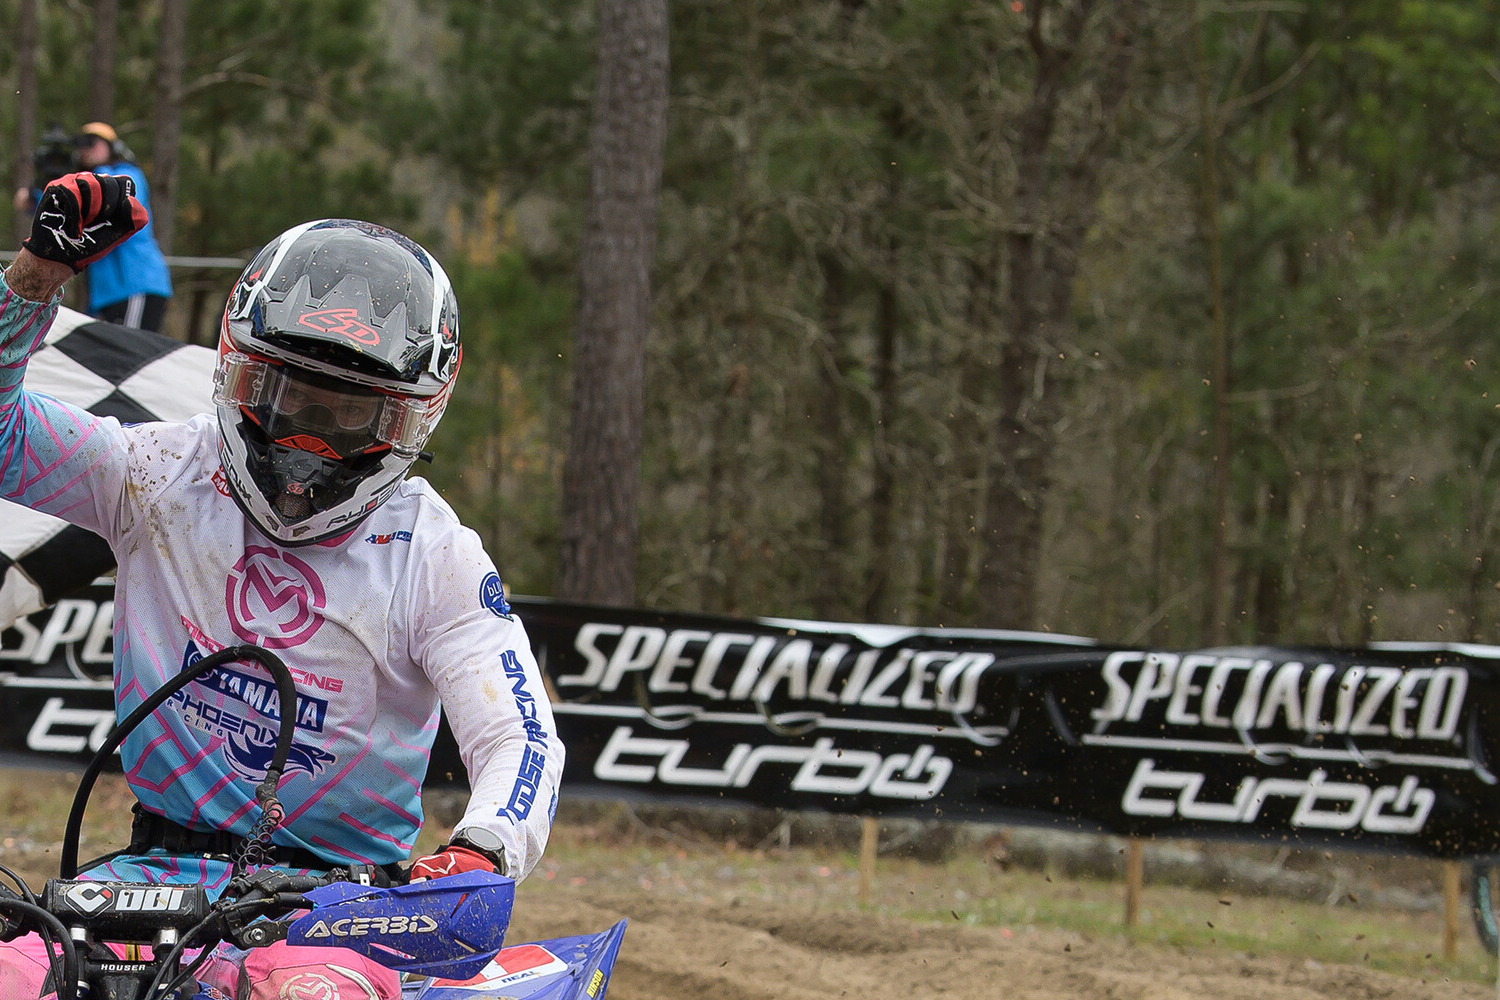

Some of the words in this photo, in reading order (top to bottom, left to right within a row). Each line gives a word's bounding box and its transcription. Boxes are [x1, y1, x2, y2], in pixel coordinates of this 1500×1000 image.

[557, 622, 995, 714] SPECIALIZED
[1090, 651, 1469, 742] SPECIALIZED
[594, 726, 953, 800] turbo
[1122, 758, 1435, 835] turbo
[305, 914, 438, 939] ACERBIS
[101, 963, 146, 972] HOUSER
